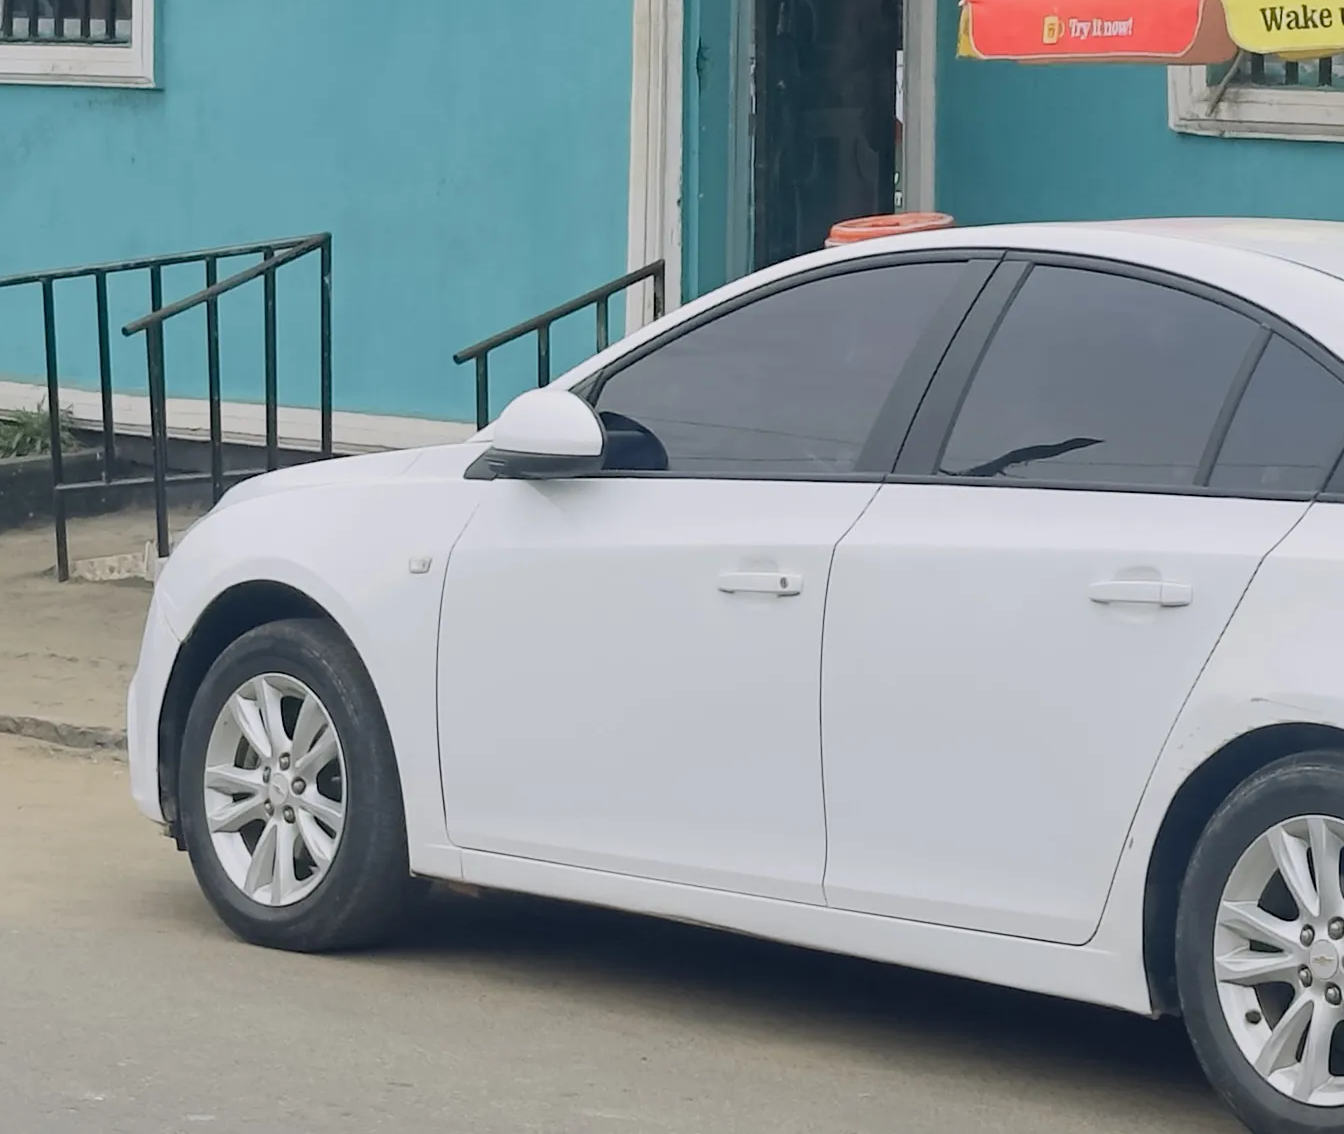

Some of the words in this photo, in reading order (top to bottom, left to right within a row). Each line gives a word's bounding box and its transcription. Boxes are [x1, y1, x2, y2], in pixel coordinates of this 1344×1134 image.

[1069, 17, 1092, 40] Try
[1092, 17, 1102, 37] it
[1102, 16, 1134, 37] now!
[1260, 4, 1333, 32] Wake
